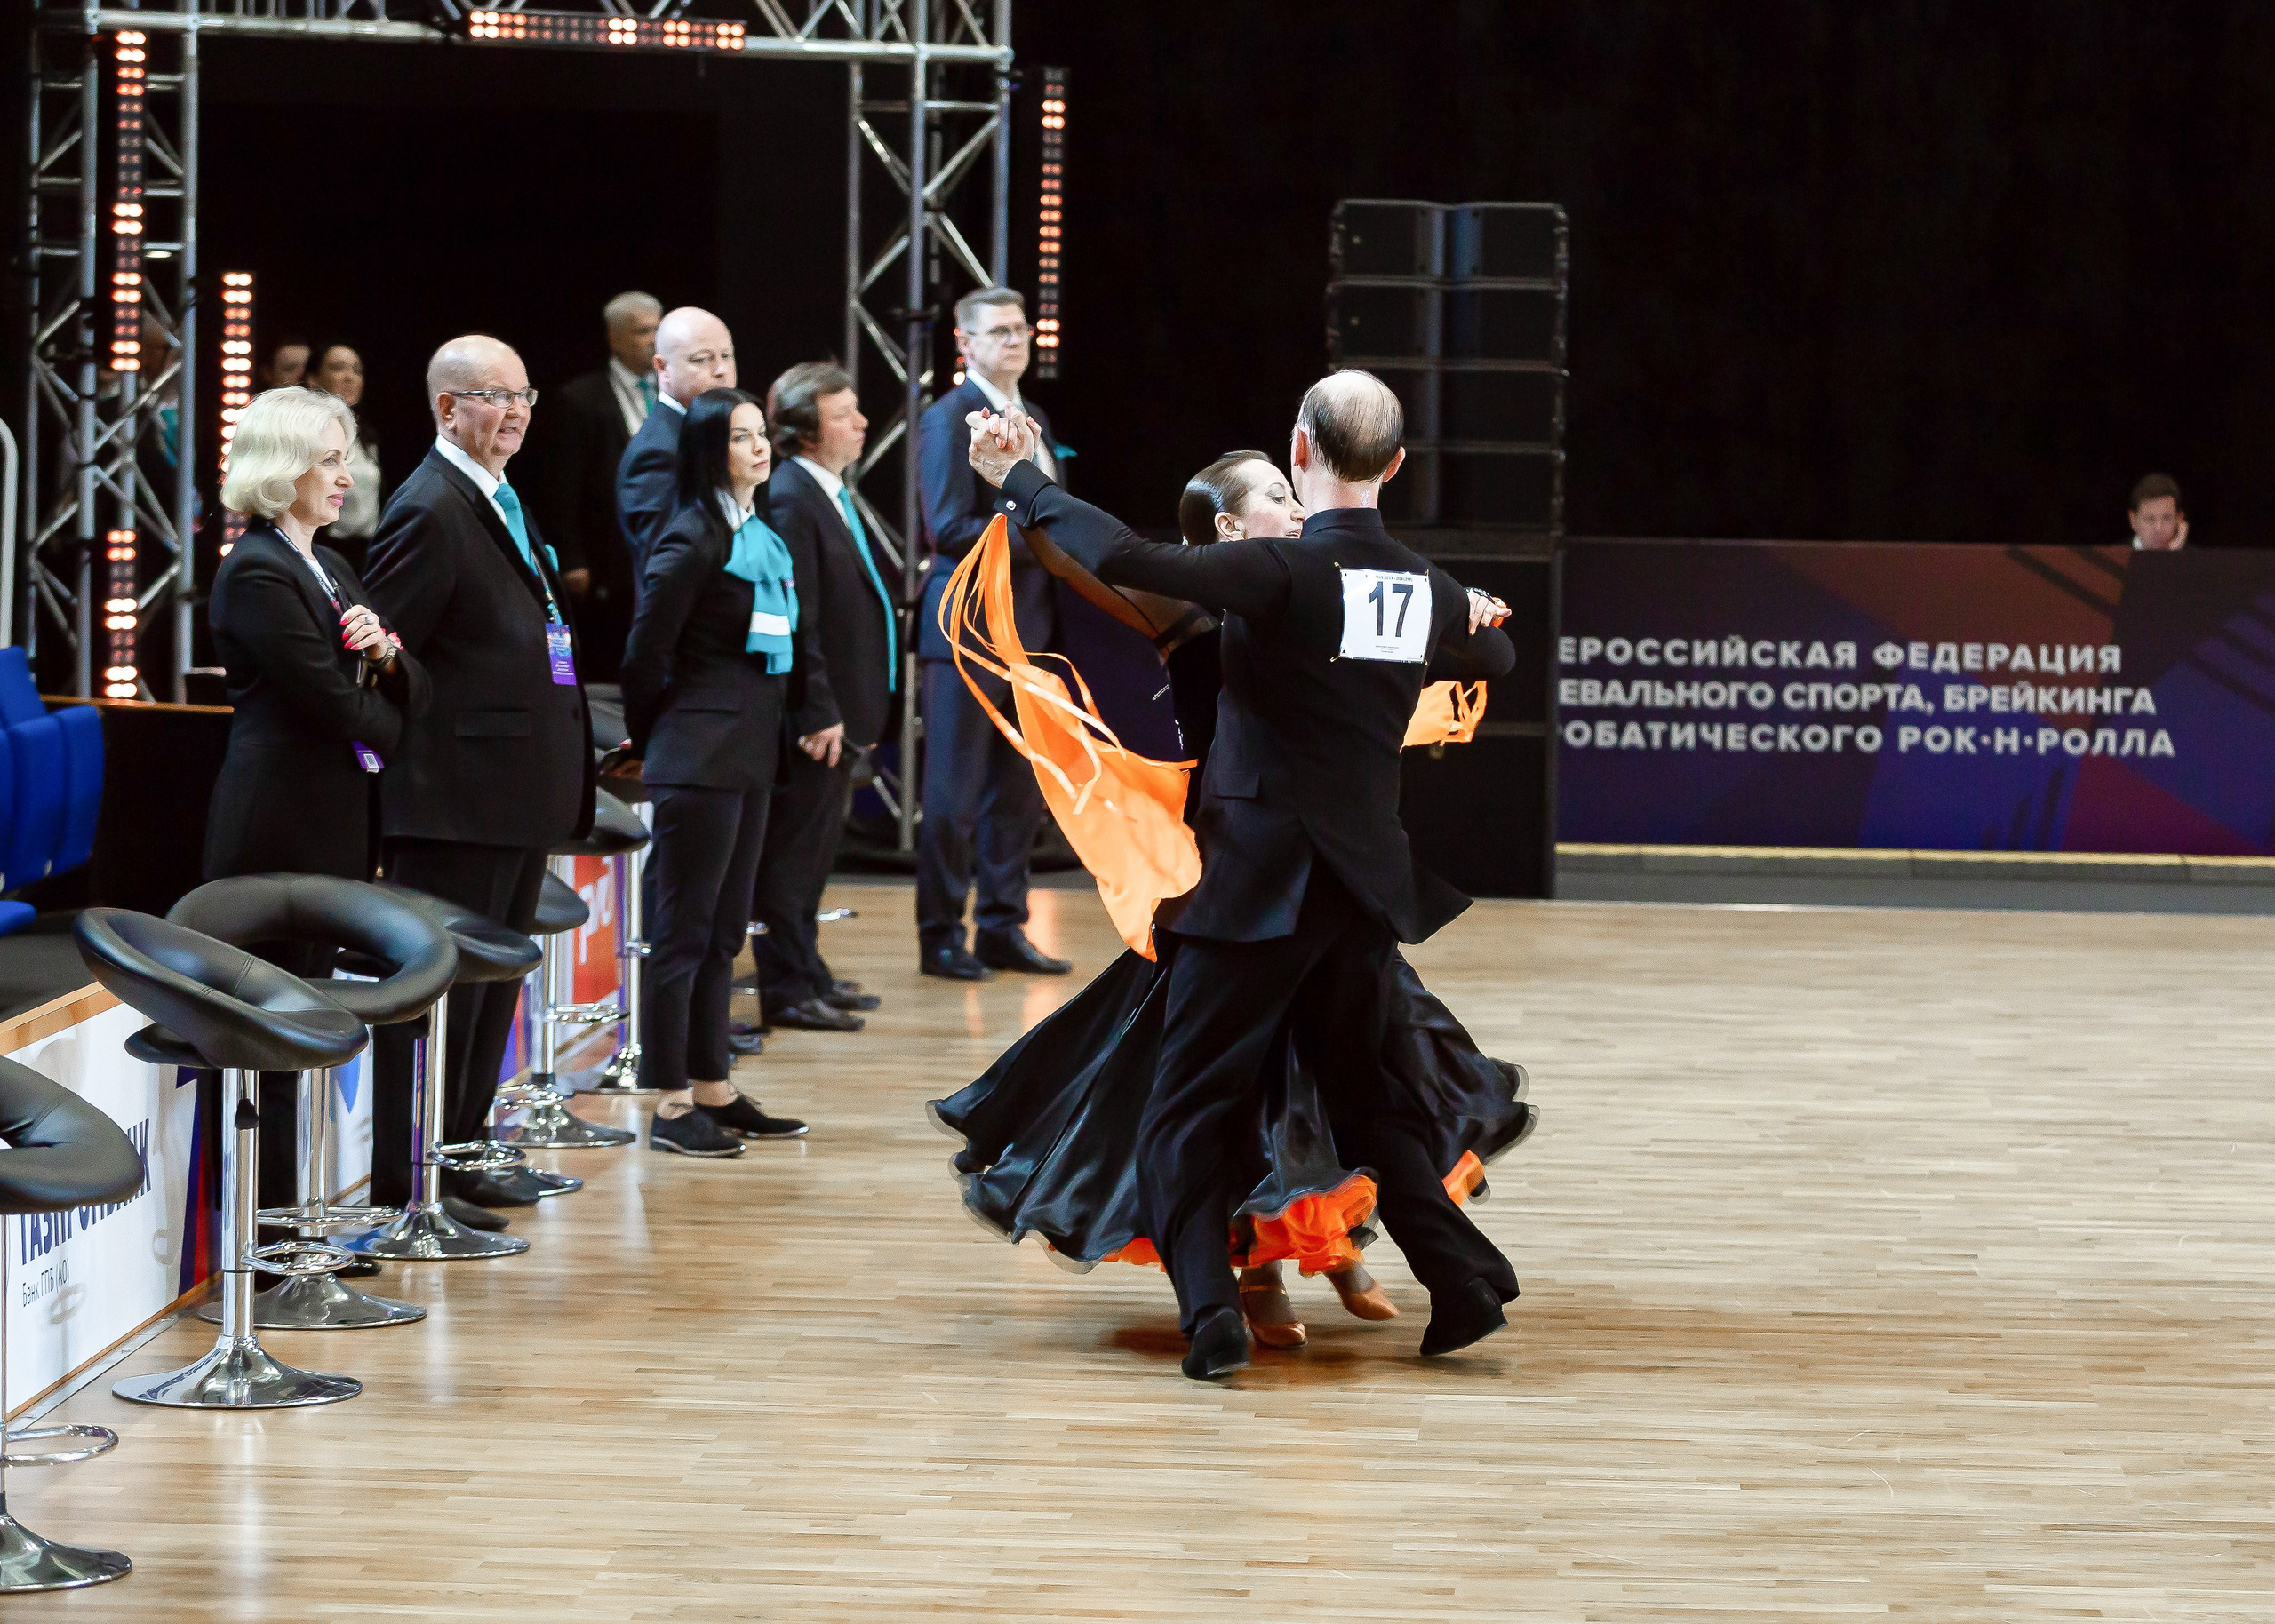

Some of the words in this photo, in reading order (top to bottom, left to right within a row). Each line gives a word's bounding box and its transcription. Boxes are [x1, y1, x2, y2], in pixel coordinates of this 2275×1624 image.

[1369, 581, 1414, 638] 17
[1558, 634, 1857, 669] ЕРОССИЙСКАЯ
[1872, 641, 2122, 676] ФЕДЕРАЦИЯ
[1558, 678, 1776, 711] ЕВАЛЬНОГО
[1782, 681, 1935, 717] СПОРТА,
[1944, 680, 2157, 716] БРЕЙКИНГА
[1557, 720, 1883, 753] ОБАТИЧЕСКОГО
[22, 1282, 40, 1308] Банк
[41, 1266, 55, 1297] ГПБ
